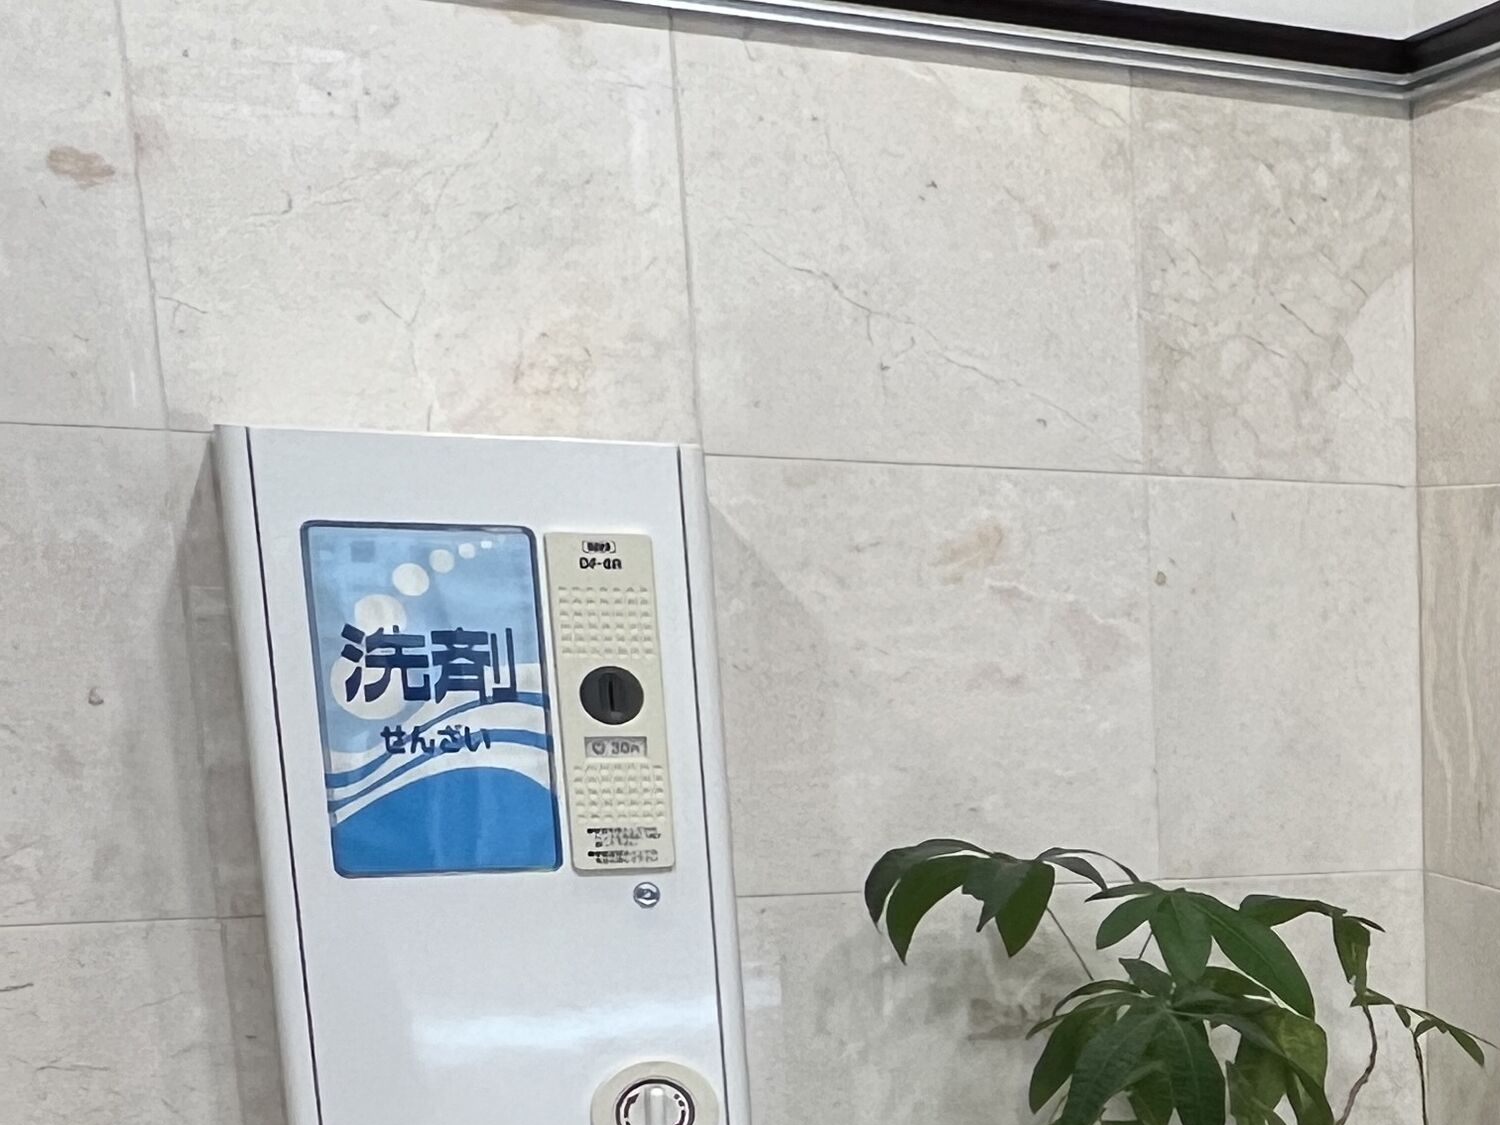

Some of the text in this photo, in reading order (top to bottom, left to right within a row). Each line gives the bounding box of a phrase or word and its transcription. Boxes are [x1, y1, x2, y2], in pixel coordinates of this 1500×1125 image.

[341, 623, 517, 704] 洗剤
[381, 725, 491, 754] せんざい
